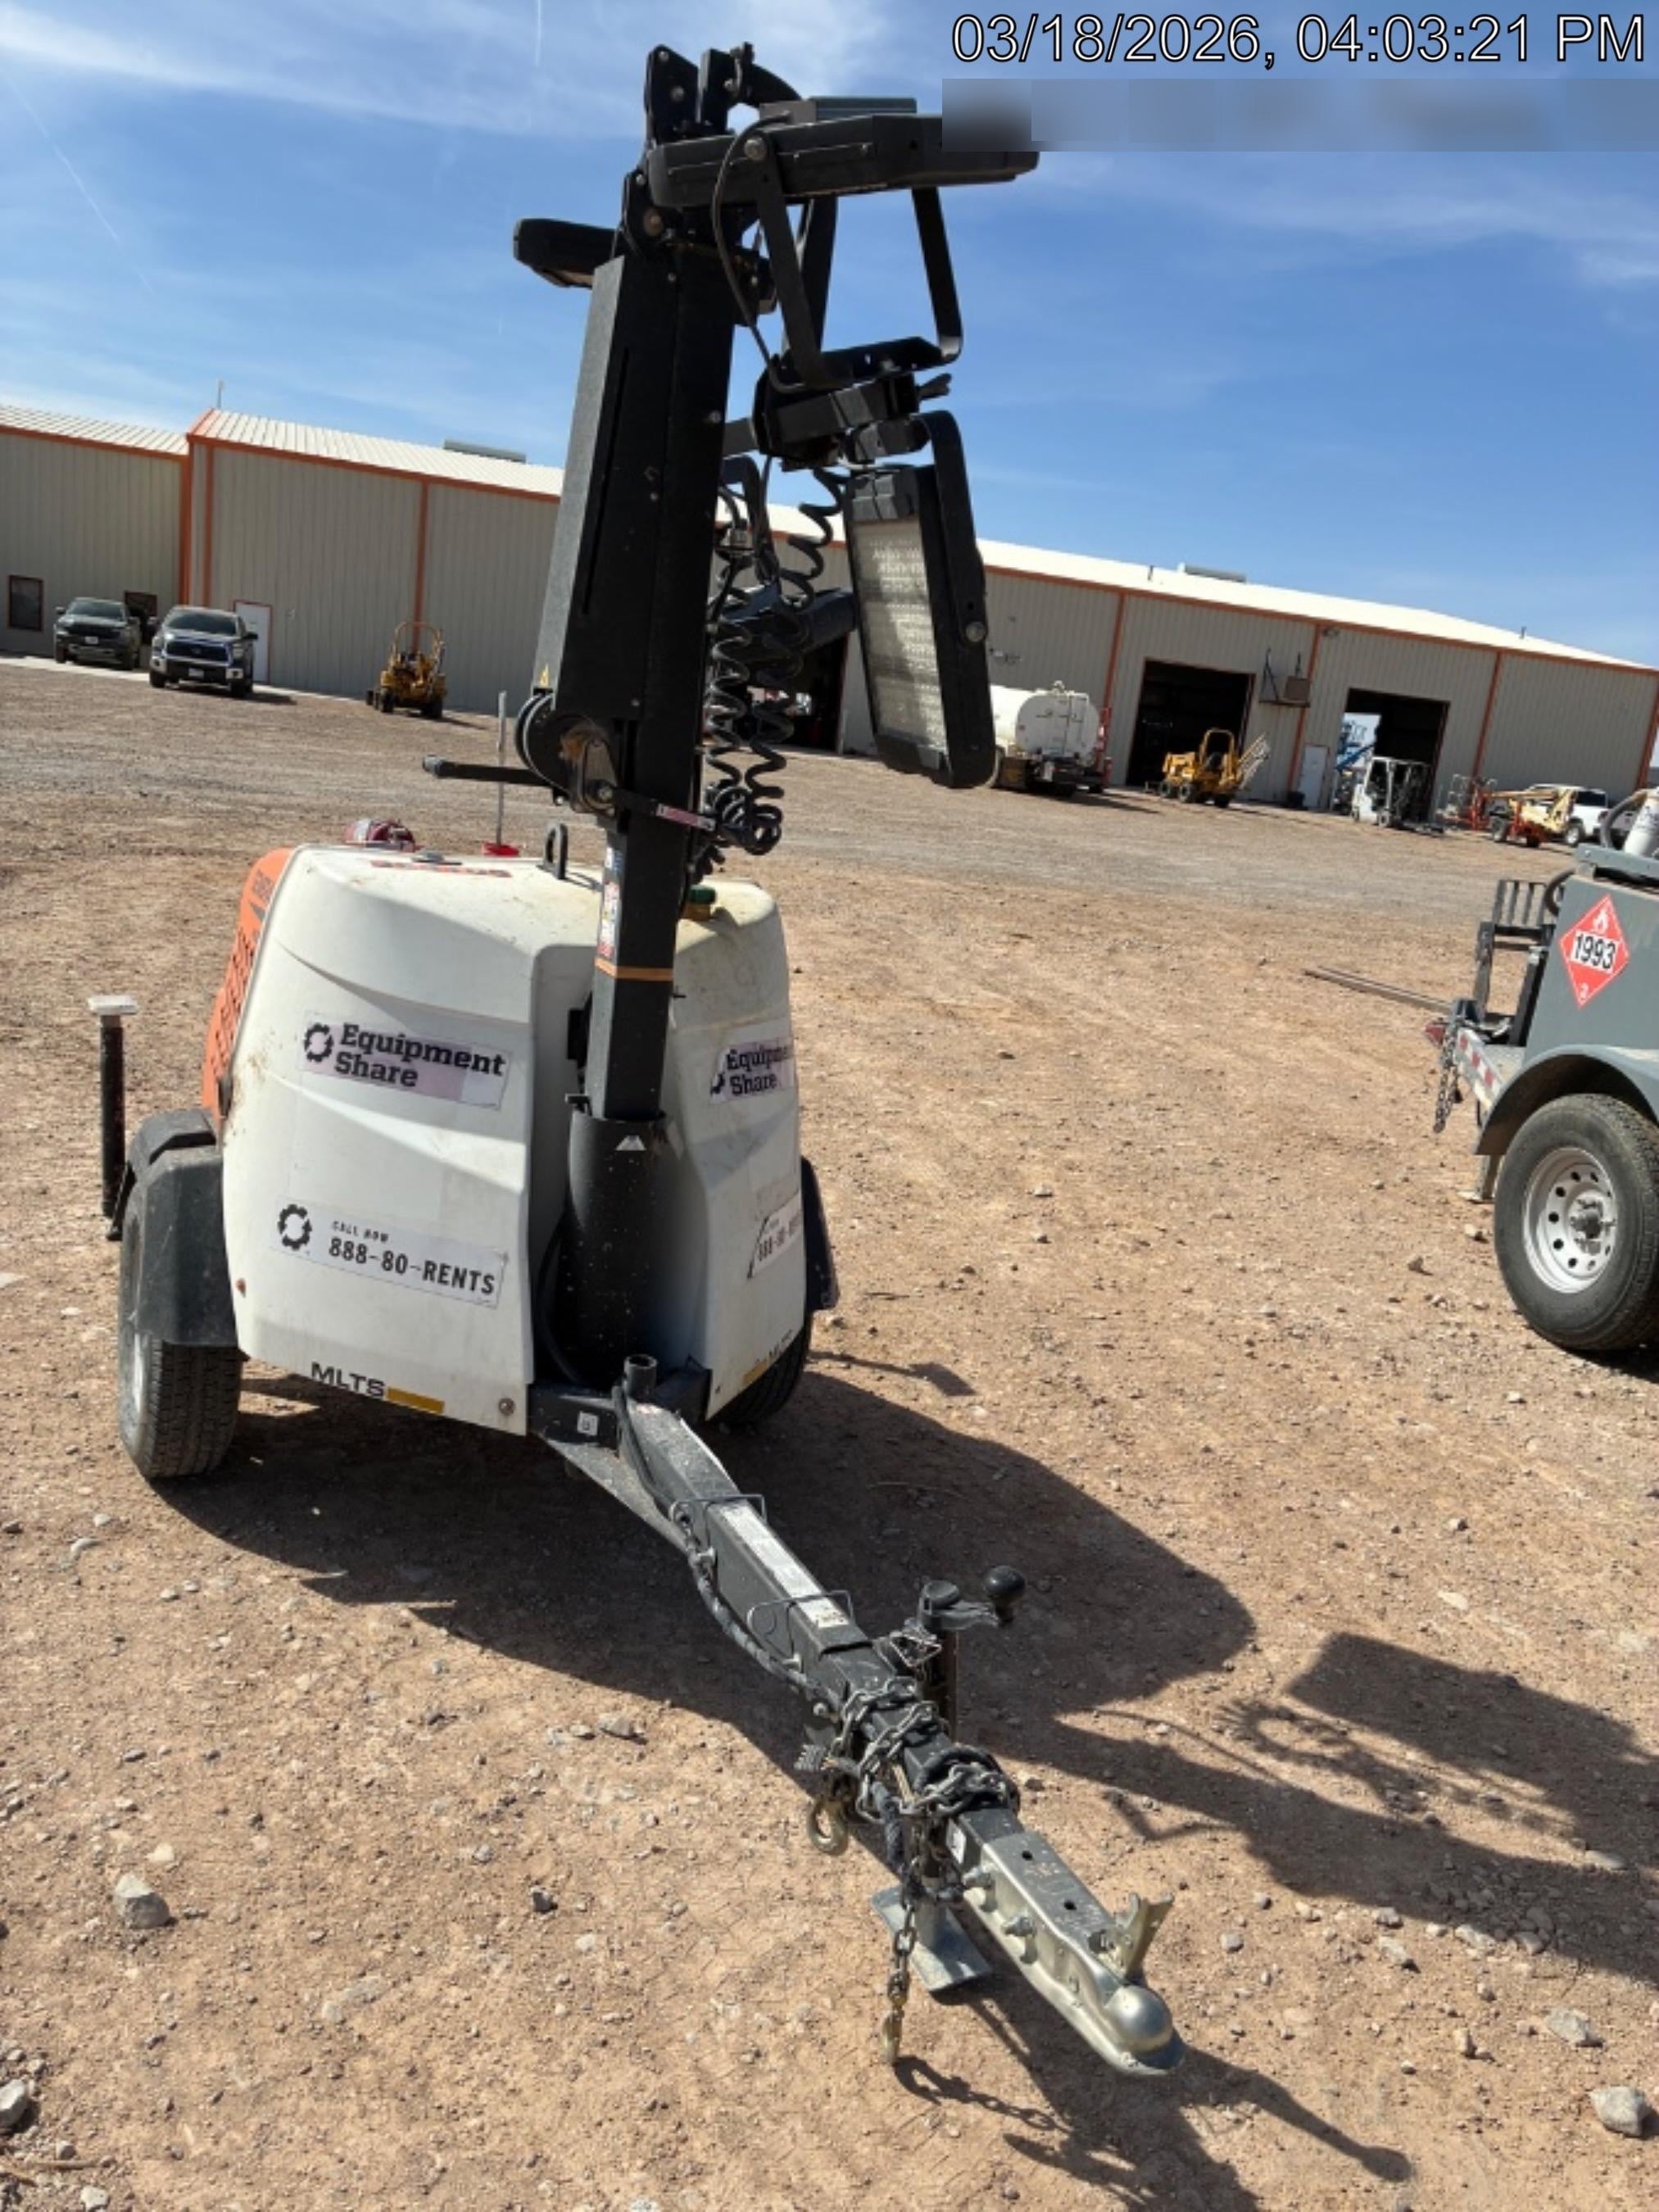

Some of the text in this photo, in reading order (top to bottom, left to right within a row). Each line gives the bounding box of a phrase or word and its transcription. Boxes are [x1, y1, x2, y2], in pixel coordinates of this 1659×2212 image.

[1575, 933, 1616, 969] 1993
[339, 1022, 507, 1077] Equipment
[333, 1051, 419, 1088] Share
[331, 1220, 389, 1244] CALL NOW
[328, 1236, 496, 1295] 888-80-RENTS
[311, 1361, 385, 1398] MLTS
